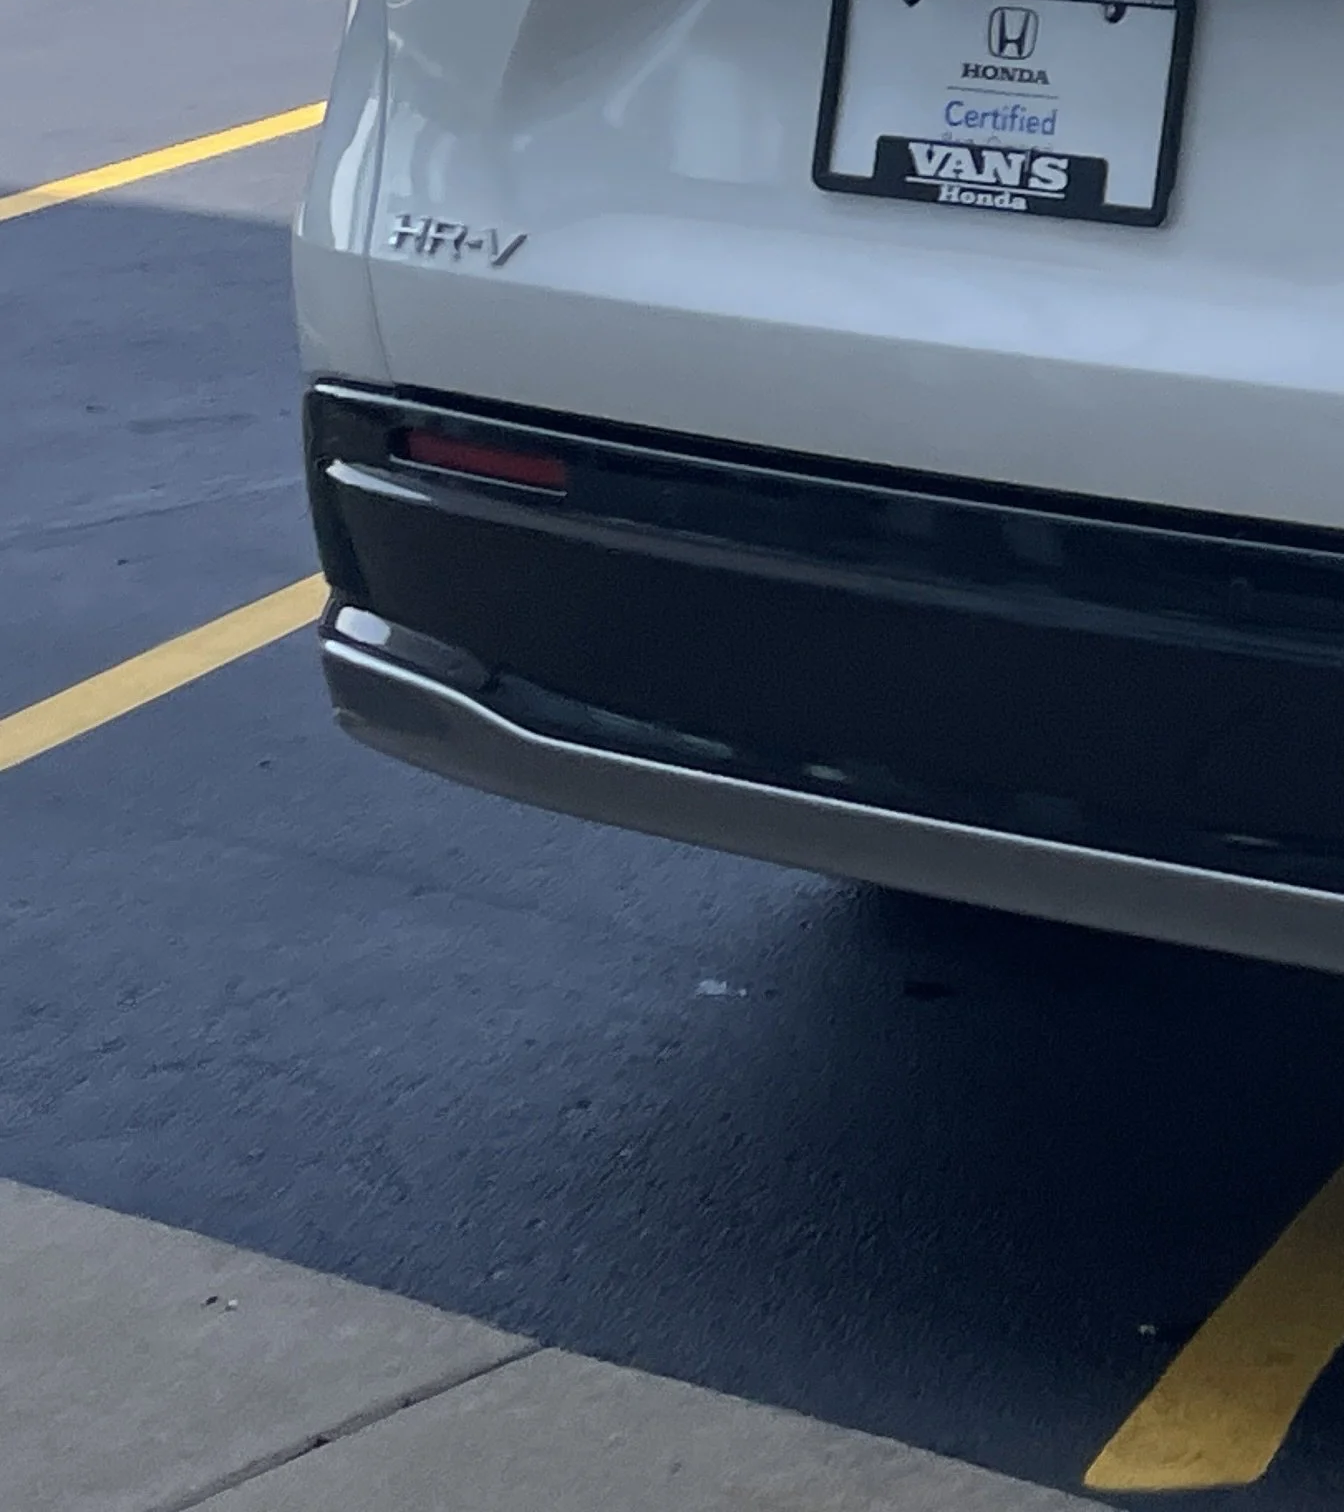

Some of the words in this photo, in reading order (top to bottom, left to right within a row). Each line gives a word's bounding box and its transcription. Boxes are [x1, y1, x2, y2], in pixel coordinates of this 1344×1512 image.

[961, 62, 1050, 85] HONDA
[944, 100, 1058, 135] Certified
[938, 185, 1028, 211] Honda
[388, 213, 529, 267] HR-V
